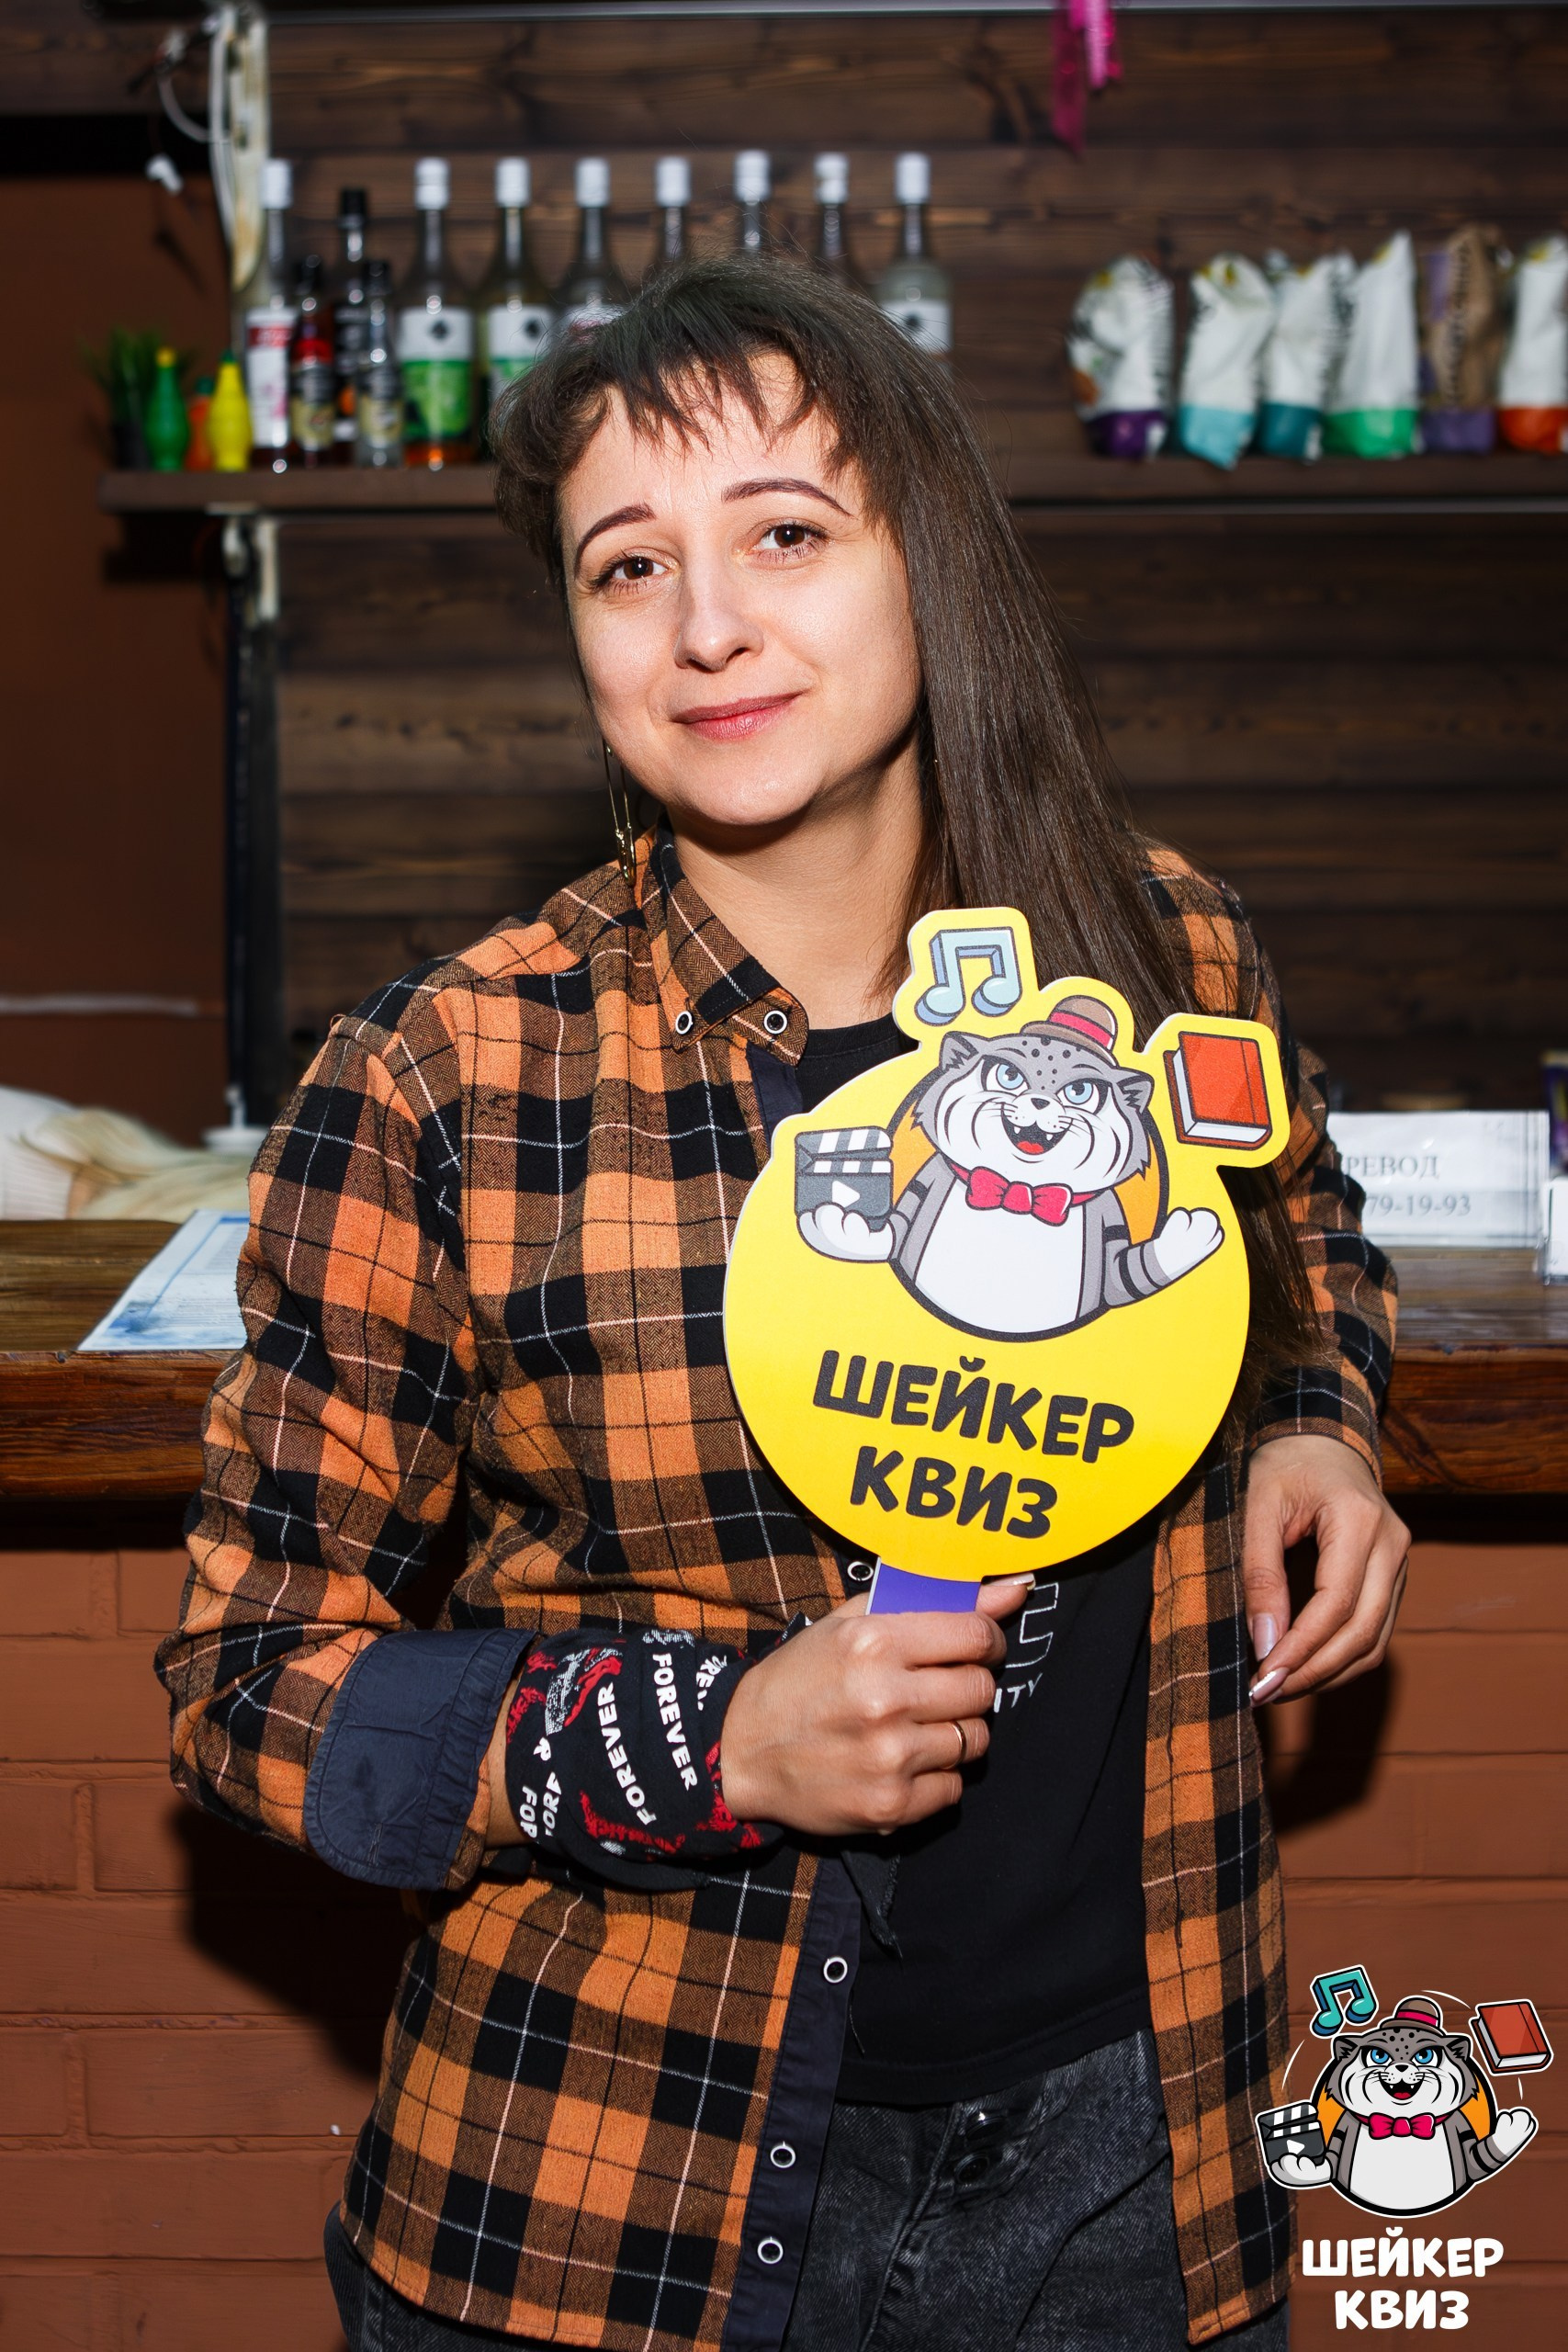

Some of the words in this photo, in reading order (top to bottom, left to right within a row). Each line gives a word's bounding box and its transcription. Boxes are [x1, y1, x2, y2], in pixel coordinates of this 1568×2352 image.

[1344, 1154, 1440, 1181] РЕВОД
[1366, 1193, 1472, 1216] 79-19-93
[813, 1350, 1134, 1464] ШЕЙКЕР
[850, 1445, 1058, 1539] КВИЗ
[597, 1681, 658, 1826] FOREVER
[652, 1653, 698, 1791] FOREVER
